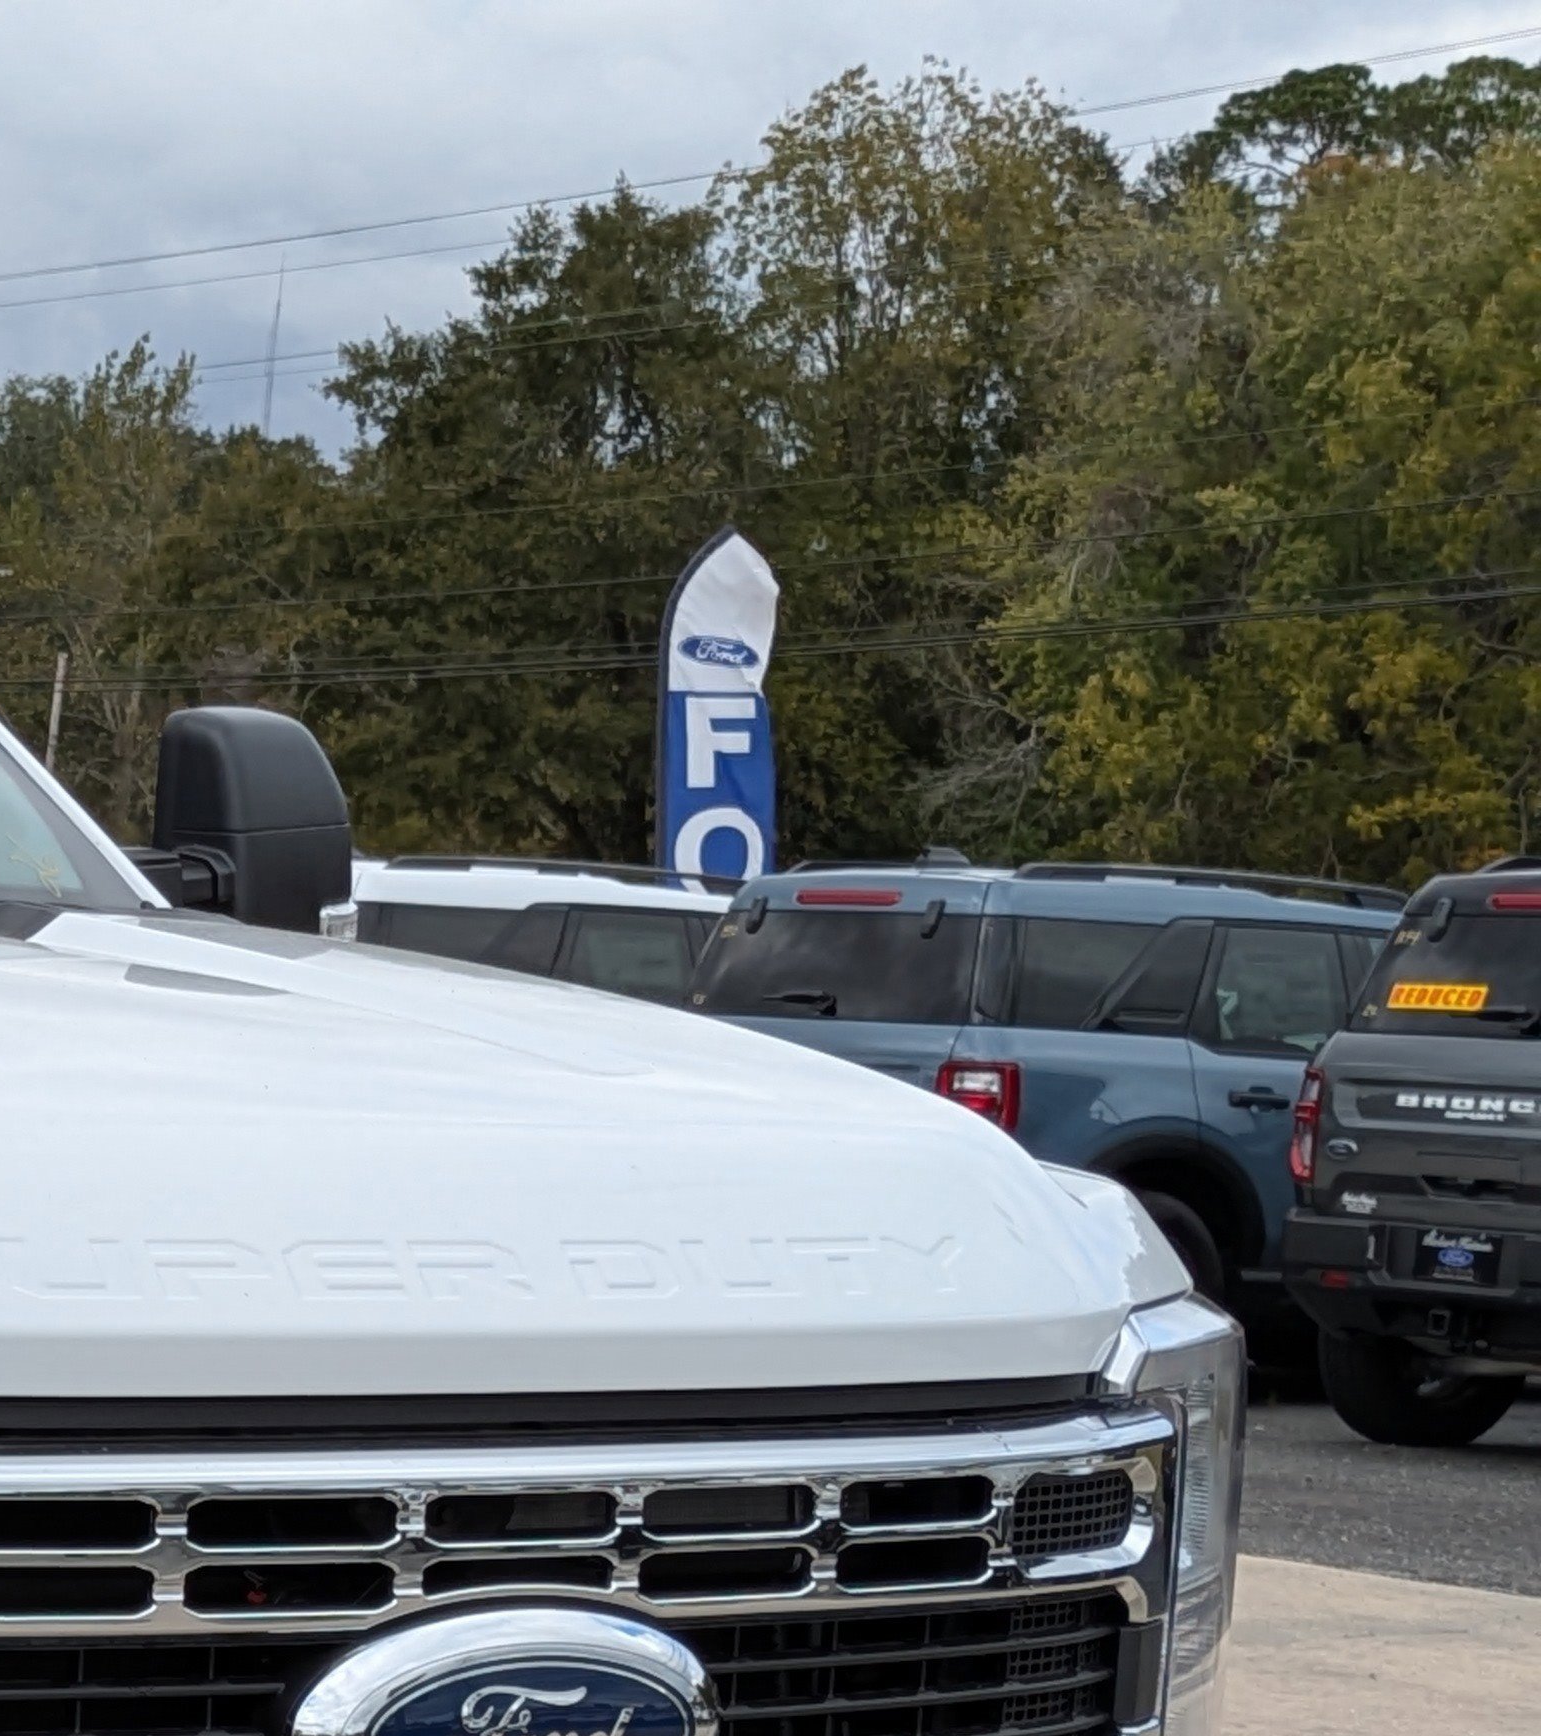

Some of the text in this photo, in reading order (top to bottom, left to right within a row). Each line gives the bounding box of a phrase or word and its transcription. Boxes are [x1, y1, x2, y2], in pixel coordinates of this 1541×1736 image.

[696, 638, 748, 665] Ford
[1391, 987, 1483, 1006] REDUCED
[1395, 1093, 1541, 1115] BRONC
[558, 1236, 963, 1300] DUTY
